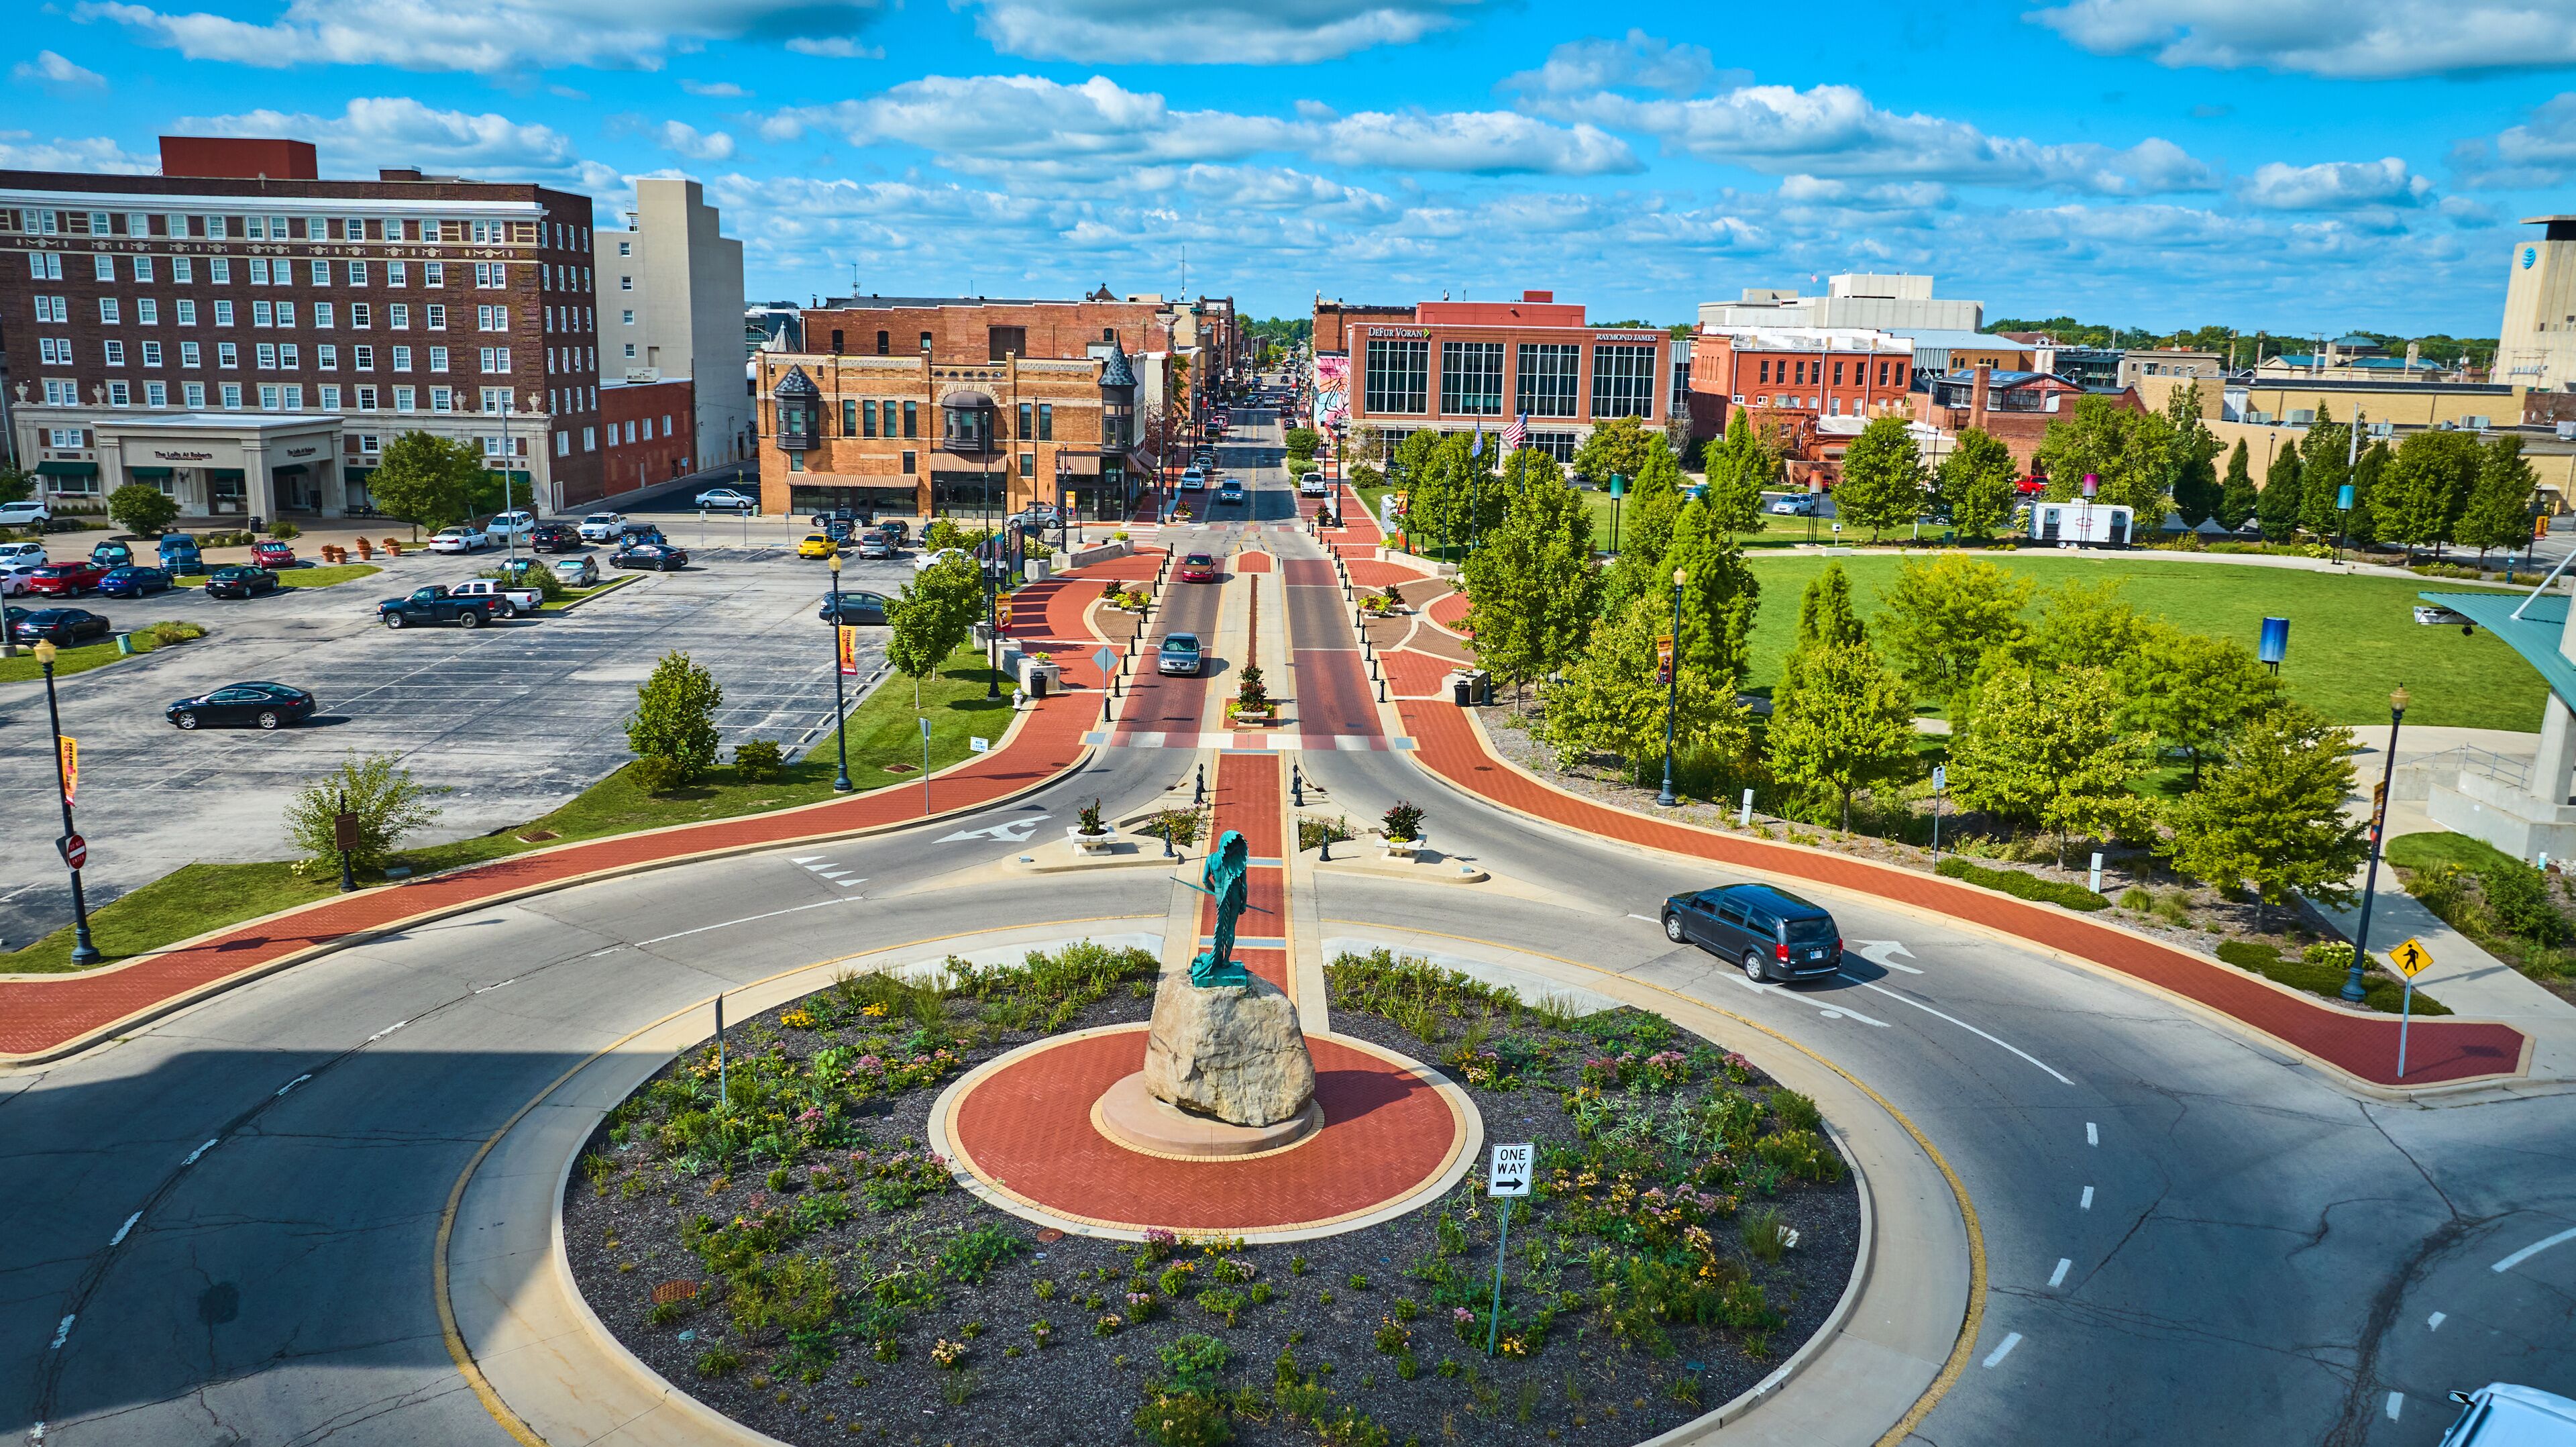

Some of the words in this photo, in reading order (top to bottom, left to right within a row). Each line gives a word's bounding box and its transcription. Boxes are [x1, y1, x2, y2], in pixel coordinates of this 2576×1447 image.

[72, 854, 85, 865] ENTER
[1500, 1148, 1526, 1161] ONE
[1497, 1163, 1526, 1175] WAY
